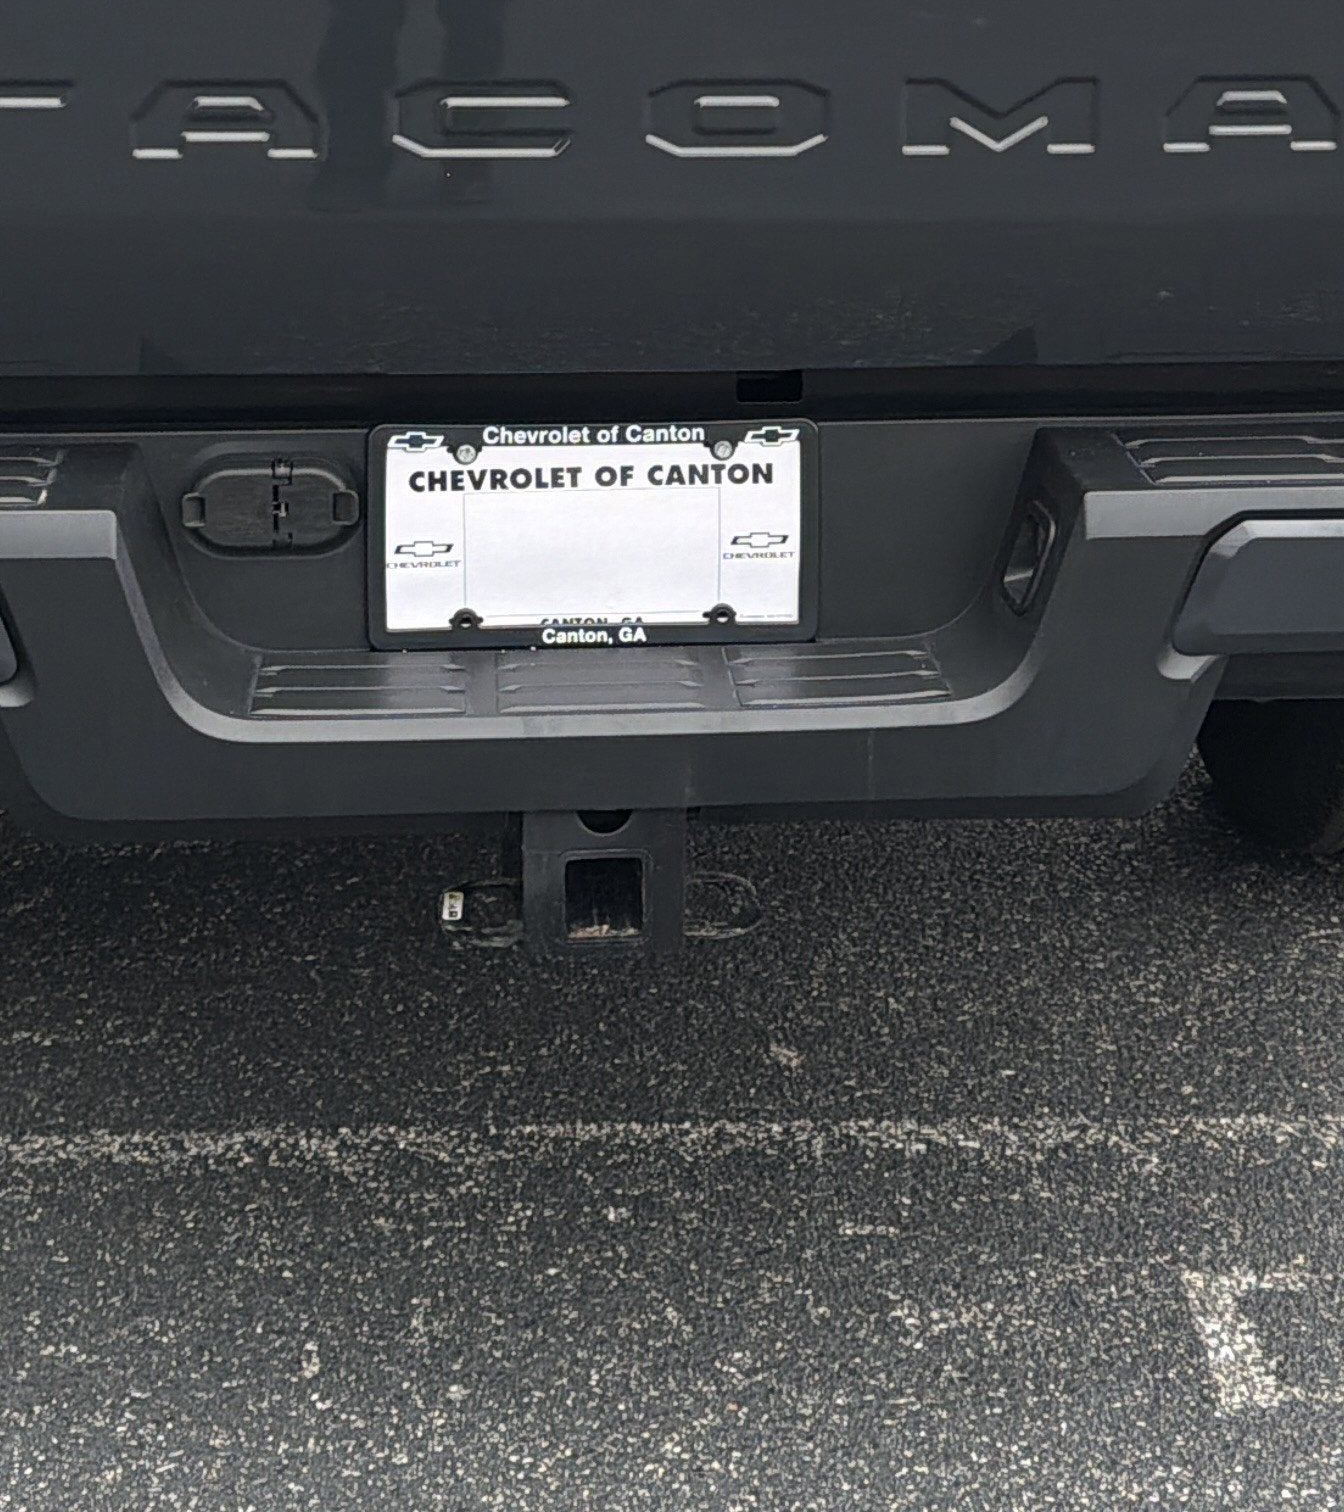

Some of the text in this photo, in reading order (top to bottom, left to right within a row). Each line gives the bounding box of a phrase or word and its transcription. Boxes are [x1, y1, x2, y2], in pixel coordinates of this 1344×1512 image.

[482, 424, 705, 445] Chevrolet of Canton
[408, 463, 773, 492] CHEVROLET OF CANTON
[386, 559, 461, 569] CHEVROLET
[722, 551, 795, 559] CHEVROLET
[542, 626, 647, 645] Canton, GA
